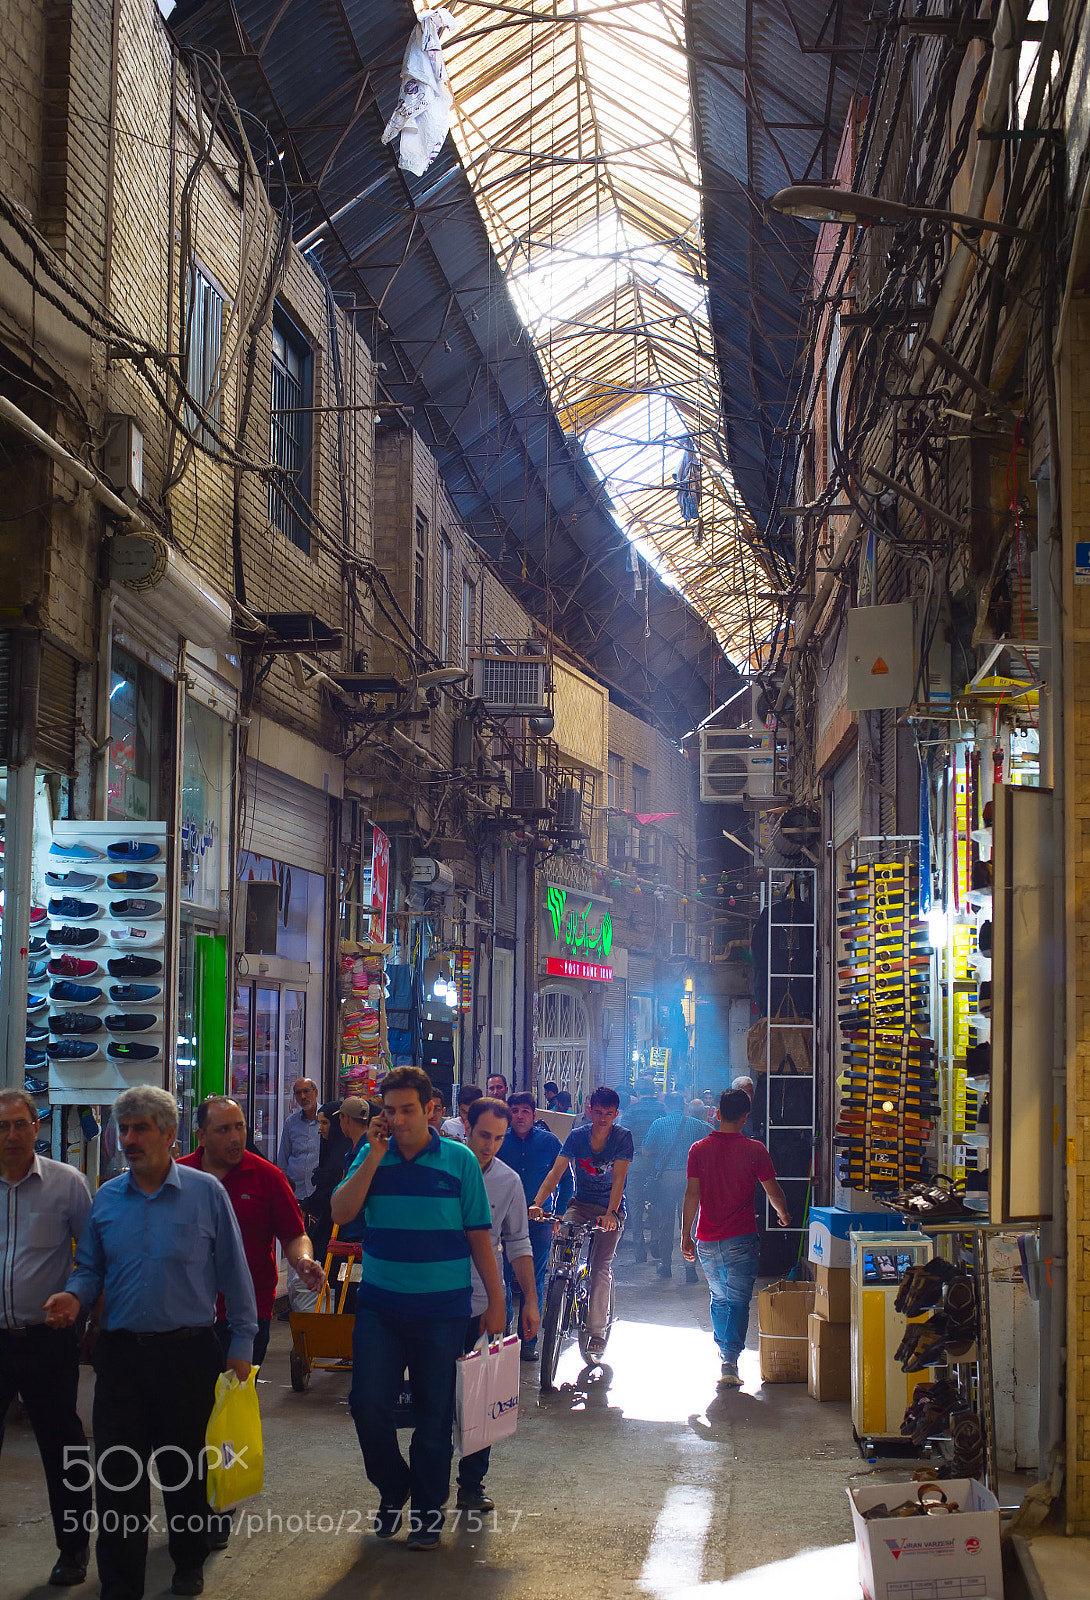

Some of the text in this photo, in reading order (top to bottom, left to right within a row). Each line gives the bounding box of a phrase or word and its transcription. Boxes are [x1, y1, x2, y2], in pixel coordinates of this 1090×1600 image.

[564, 961, 613, 980] POST BANK IRAN
